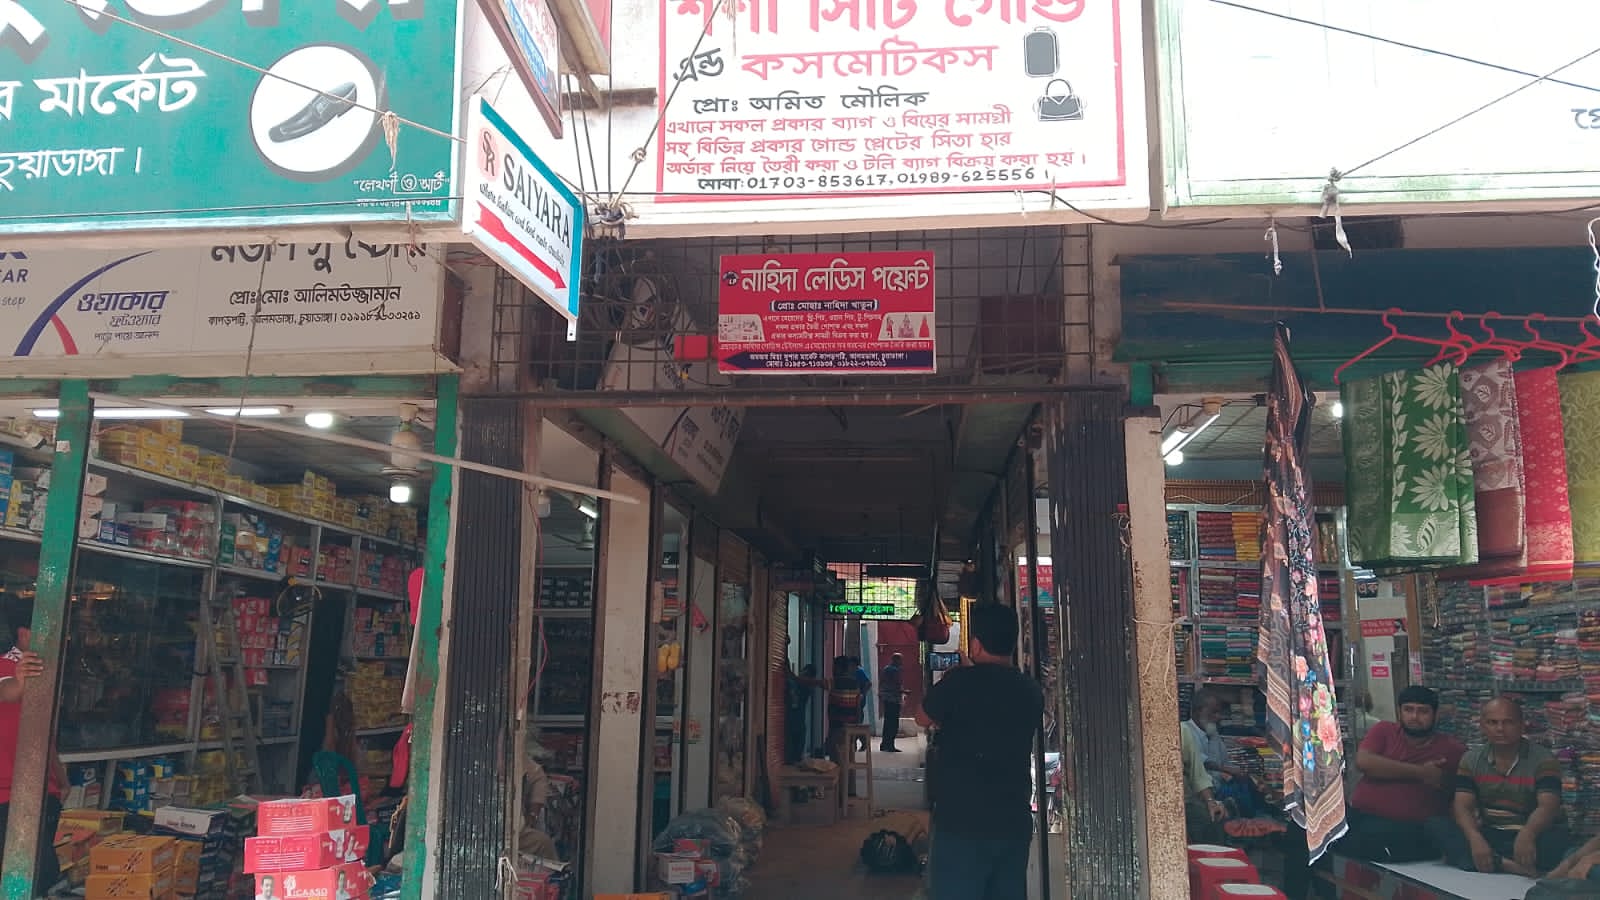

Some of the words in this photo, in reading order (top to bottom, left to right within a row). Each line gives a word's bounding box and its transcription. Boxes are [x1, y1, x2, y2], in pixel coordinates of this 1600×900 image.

[33, 52, 207, 117] মার্কেট
[749, 90, 826, 110] অমিত
[840, 85, 929, 109] মৌলিক
[666, 120, 716, 134] এখানে
[719, 118, 767, 132] সকল
[771, 117, 826, 132] প্রকার
[832, 116, 875, 130] ব্যাগ
[902, 109, 949, 129] বিয়ের
[956, 104, 1013, 125] সামগ্রী
[666, 140, 692, 157] সহ
[697, 137, 745, 154] বিভিন্ন
[750, 138, 805, 153] প্রকার
[931, 130, 973, 149] সিতা
[980, 132, 1013, 150] হার
[666, 157, 714, 175] অর্ডার
[720, 157, 756, 175] নিয়ে
[760, 155, 801, 174] তৈরী
[804, 159, 839, 174] করা
[902, 158, 941, 171] ব্যাগ
[947, 152, 996, 169] বিক্রয়
[1000, 154, 1039, 168] করা
[504, 153, 570, 249] SAIYARA
[741, 259, 799, 293] নাহিদা
[804, 258, 866, 291] লেডিস
[872, 258, 930, 292] পয়েন্ট
[77, 291, 169, 315] ওয়াকার
[262, 289, 289, 304] মোঃ
